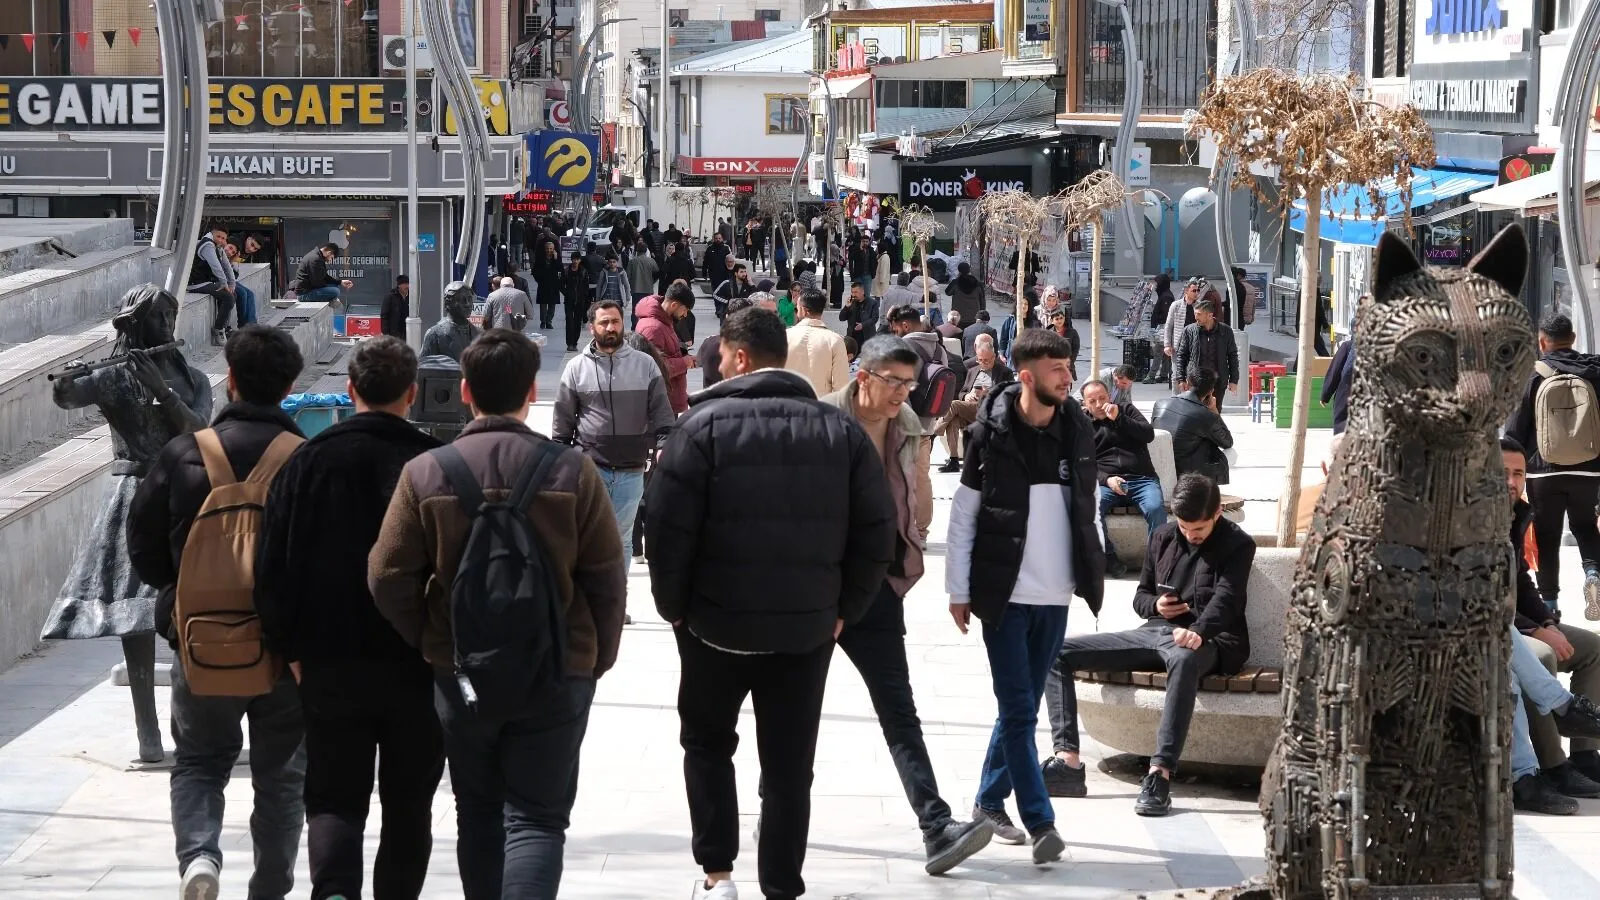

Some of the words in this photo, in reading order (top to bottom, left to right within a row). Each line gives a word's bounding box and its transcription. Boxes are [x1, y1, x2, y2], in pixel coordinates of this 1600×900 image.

[18, 83, 160, 125] GAME
[1485, 80, 1519, 113] MARKET
[0, 155, 16, 174] U
[208, 156, 275, 174] HAKAN
[910, 178, 962, 197] DÖNER
[986, 180, 1024, 194] KING
